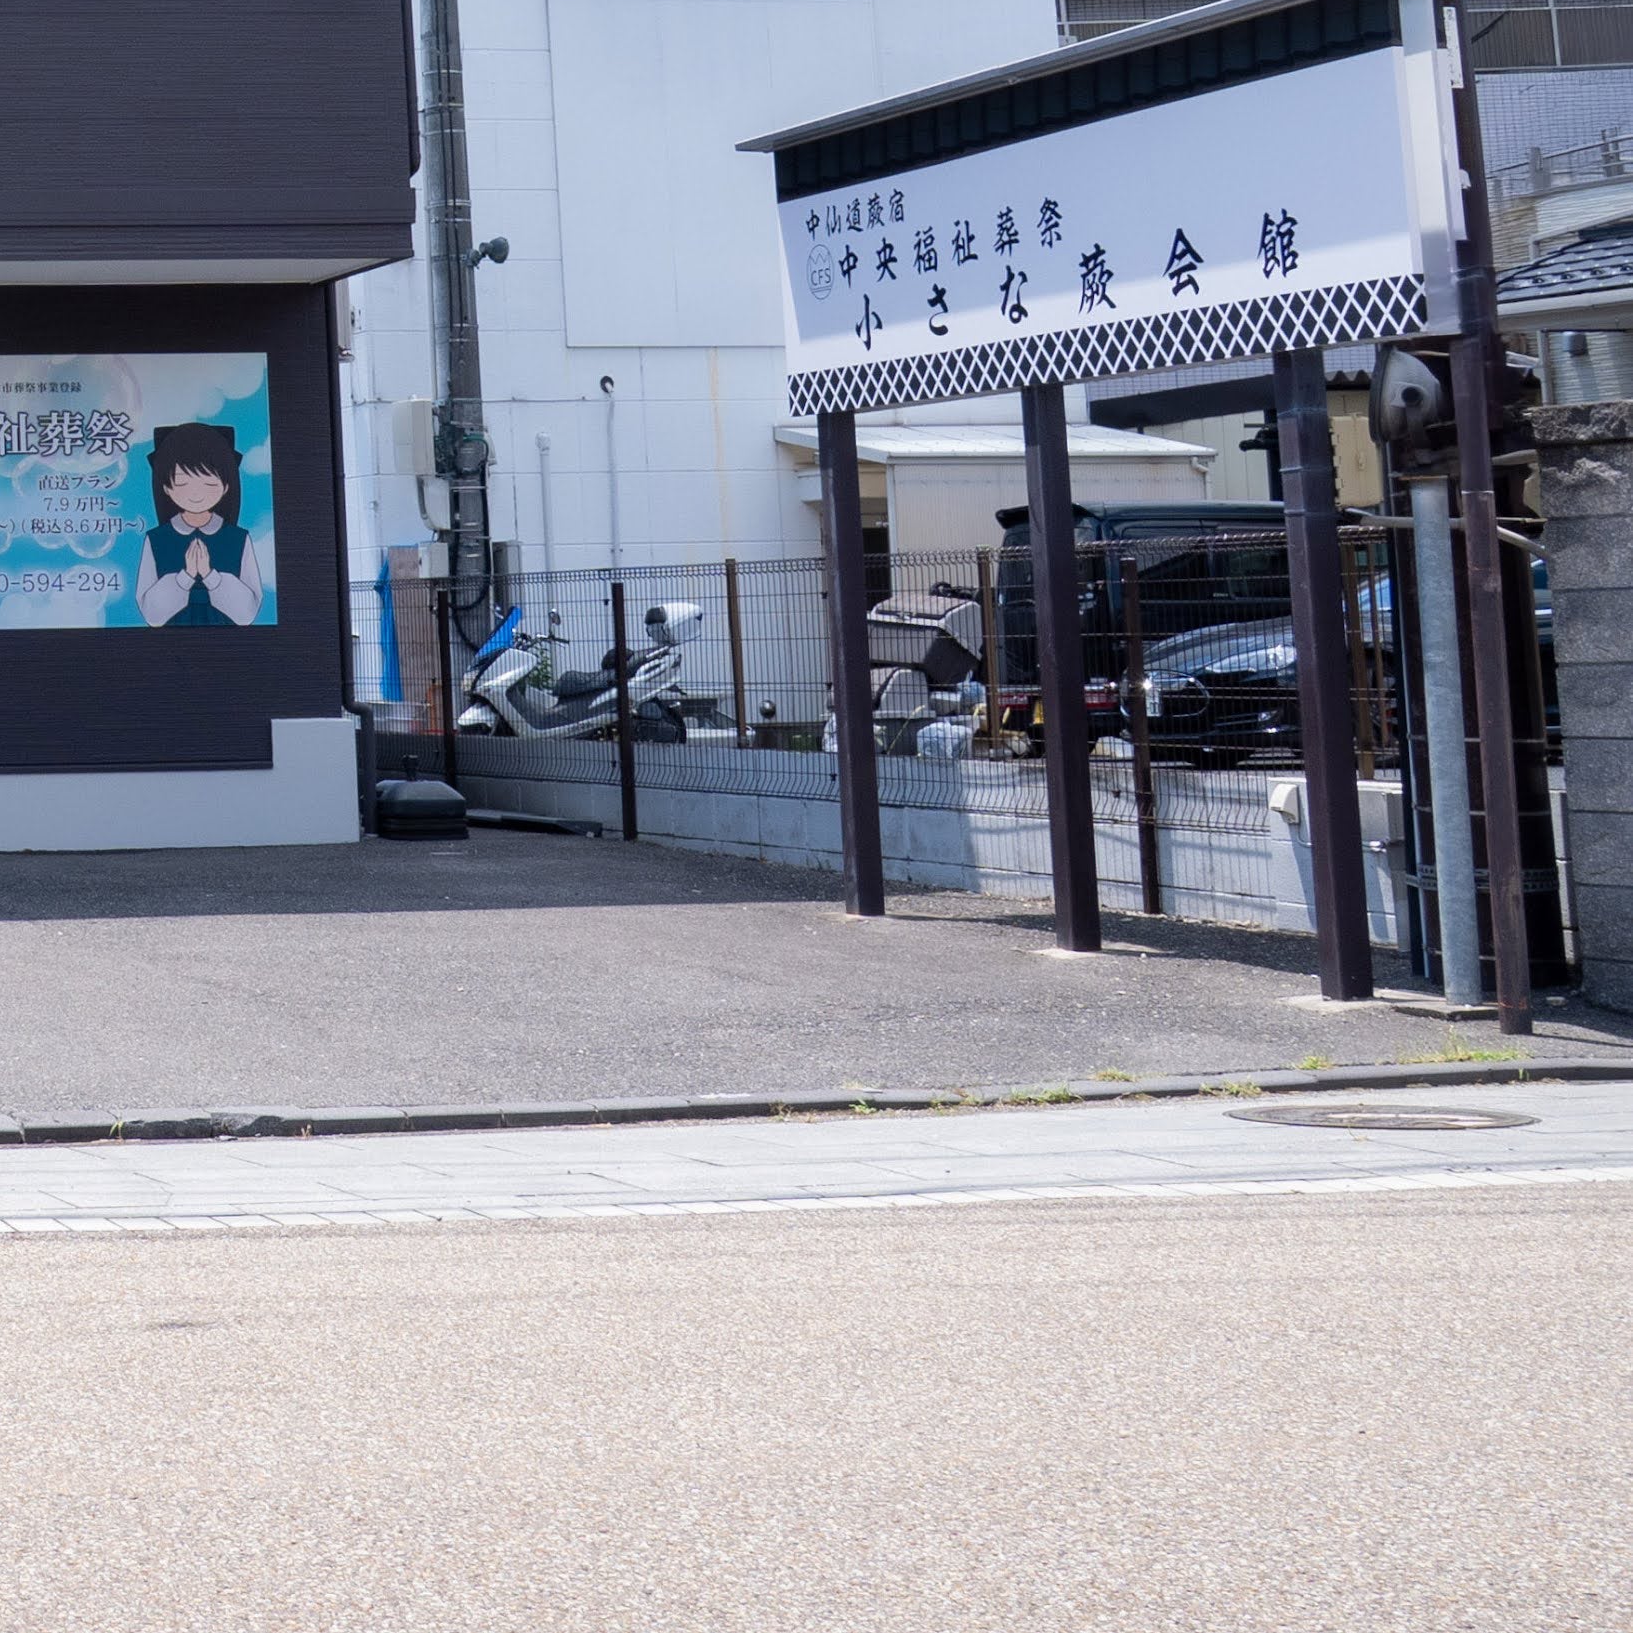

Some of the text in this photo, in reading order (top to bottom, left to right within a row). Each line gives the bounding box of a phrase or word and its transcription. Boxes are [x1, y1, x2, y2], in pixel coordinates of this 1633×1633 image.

[805, 188, 905, 241] 中仙道蕨宿
[837, 196, 1063, 288] 中央福祉葬祭
[810, 268, 832, 286] CFS
[855, 208, 1300, 351] 小さな蕨会館
